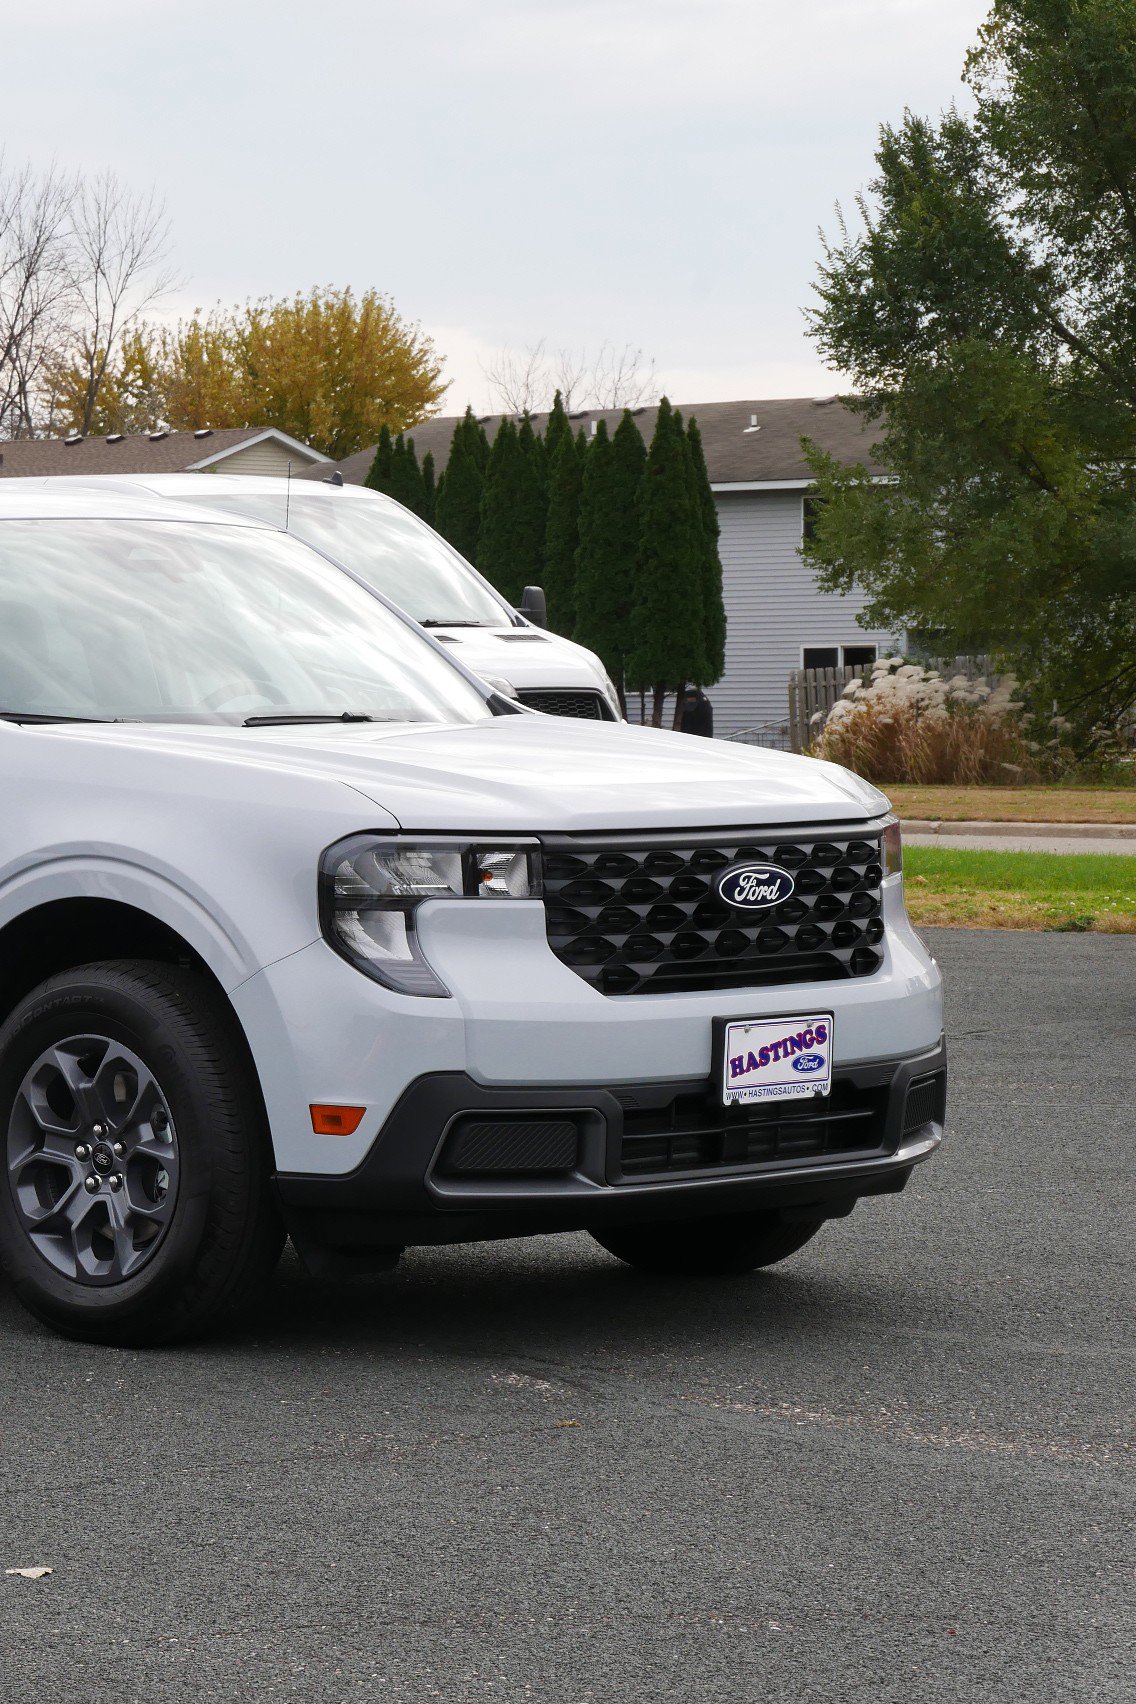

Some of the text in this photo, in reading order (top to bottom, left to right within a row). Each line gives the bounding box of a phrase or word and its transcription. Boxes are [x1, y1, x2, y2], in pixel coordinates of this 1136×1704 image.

[734, 873, 781, 901] Ford
[730, 1024, 827, 1078] HASTINGS
[797, 1056, 819, 1069] Ford
[748, 1085, 805, 1098] HASTINGSAUTOS
